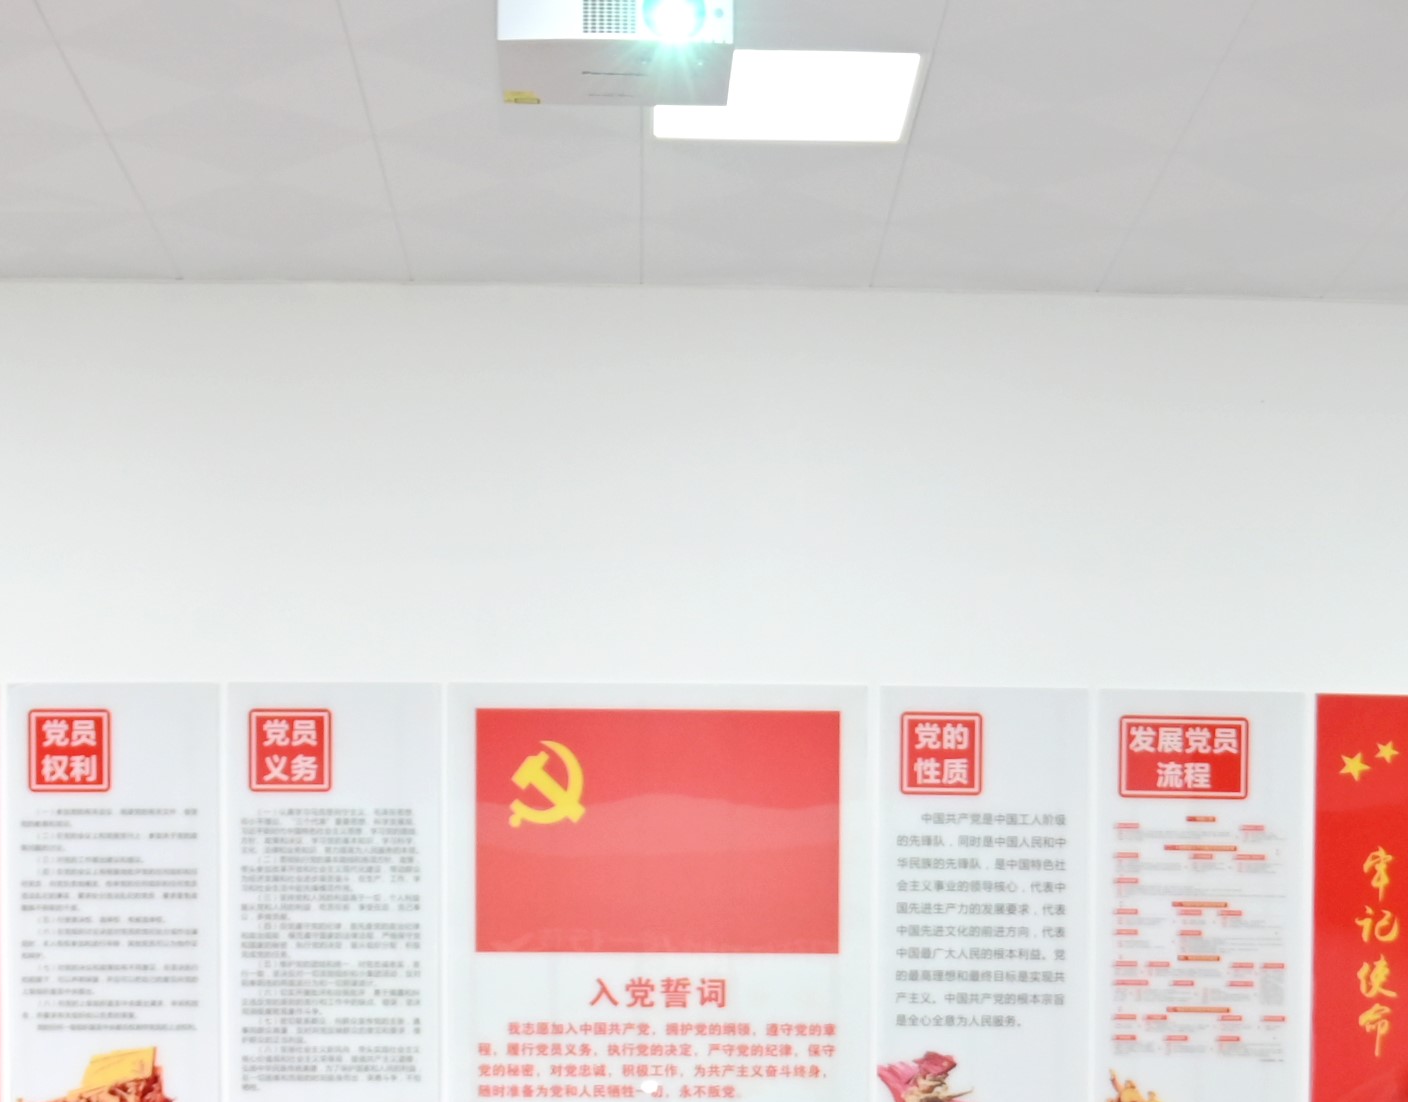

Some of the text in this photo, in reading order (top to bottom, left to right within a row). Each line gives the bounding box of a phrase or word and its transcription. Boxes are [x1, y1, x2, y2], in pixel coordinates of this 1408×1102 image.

[41, 718, 98, 747] 党员
[262, 718, 318, 747] 党员
[914, 722, 969, 751] 党的
[1128, 727, 1239, 756] 发展党员
[40, 753, 98, 784] 权利
[262, 753, 319, 783] 义务
[913, 758, 969, 787] 性质
[1155, 761, 1212, 790] 流程
[1354, 845, 1400, 1058] 牢记使命
[589, 976, 727, 1009] 入党誓词
